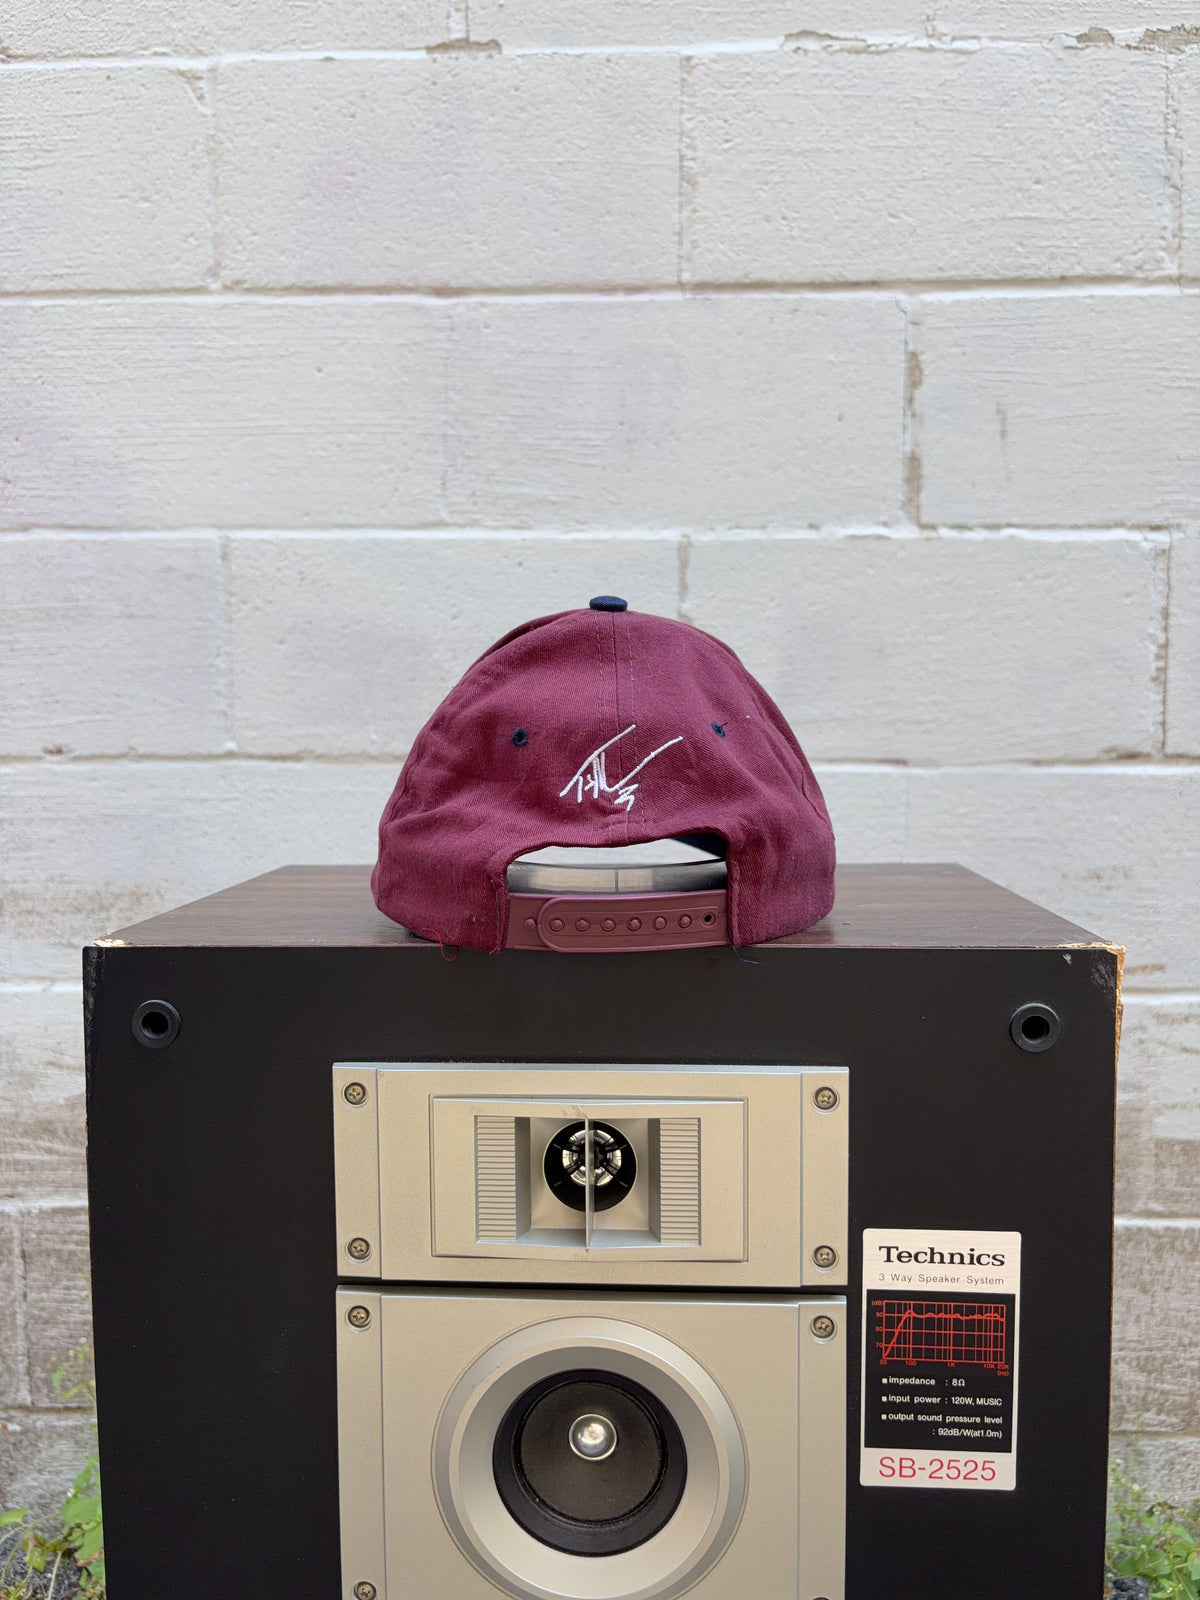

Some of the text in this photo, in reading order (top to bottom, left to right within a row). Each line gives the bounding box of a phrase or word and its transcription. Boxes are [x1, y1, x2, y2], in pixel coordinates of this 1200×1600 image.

[878, 1246, 1006, 1266] Technics
[878, 1272, 1004, 1286] 3 Way Speaker System
[888, 1376, 936, 1386] impedance
[952, 1378, 966, 1386] 8Ω
[888, 1394, 910, 1403] input
[914, 1396, 941, 1404] power
[976, 1398, 1002, 1406] MUSIC
[888, 1412, 1002, 1424] output sound pressure level
[879, 1456, 996, 1482] SB-2525
